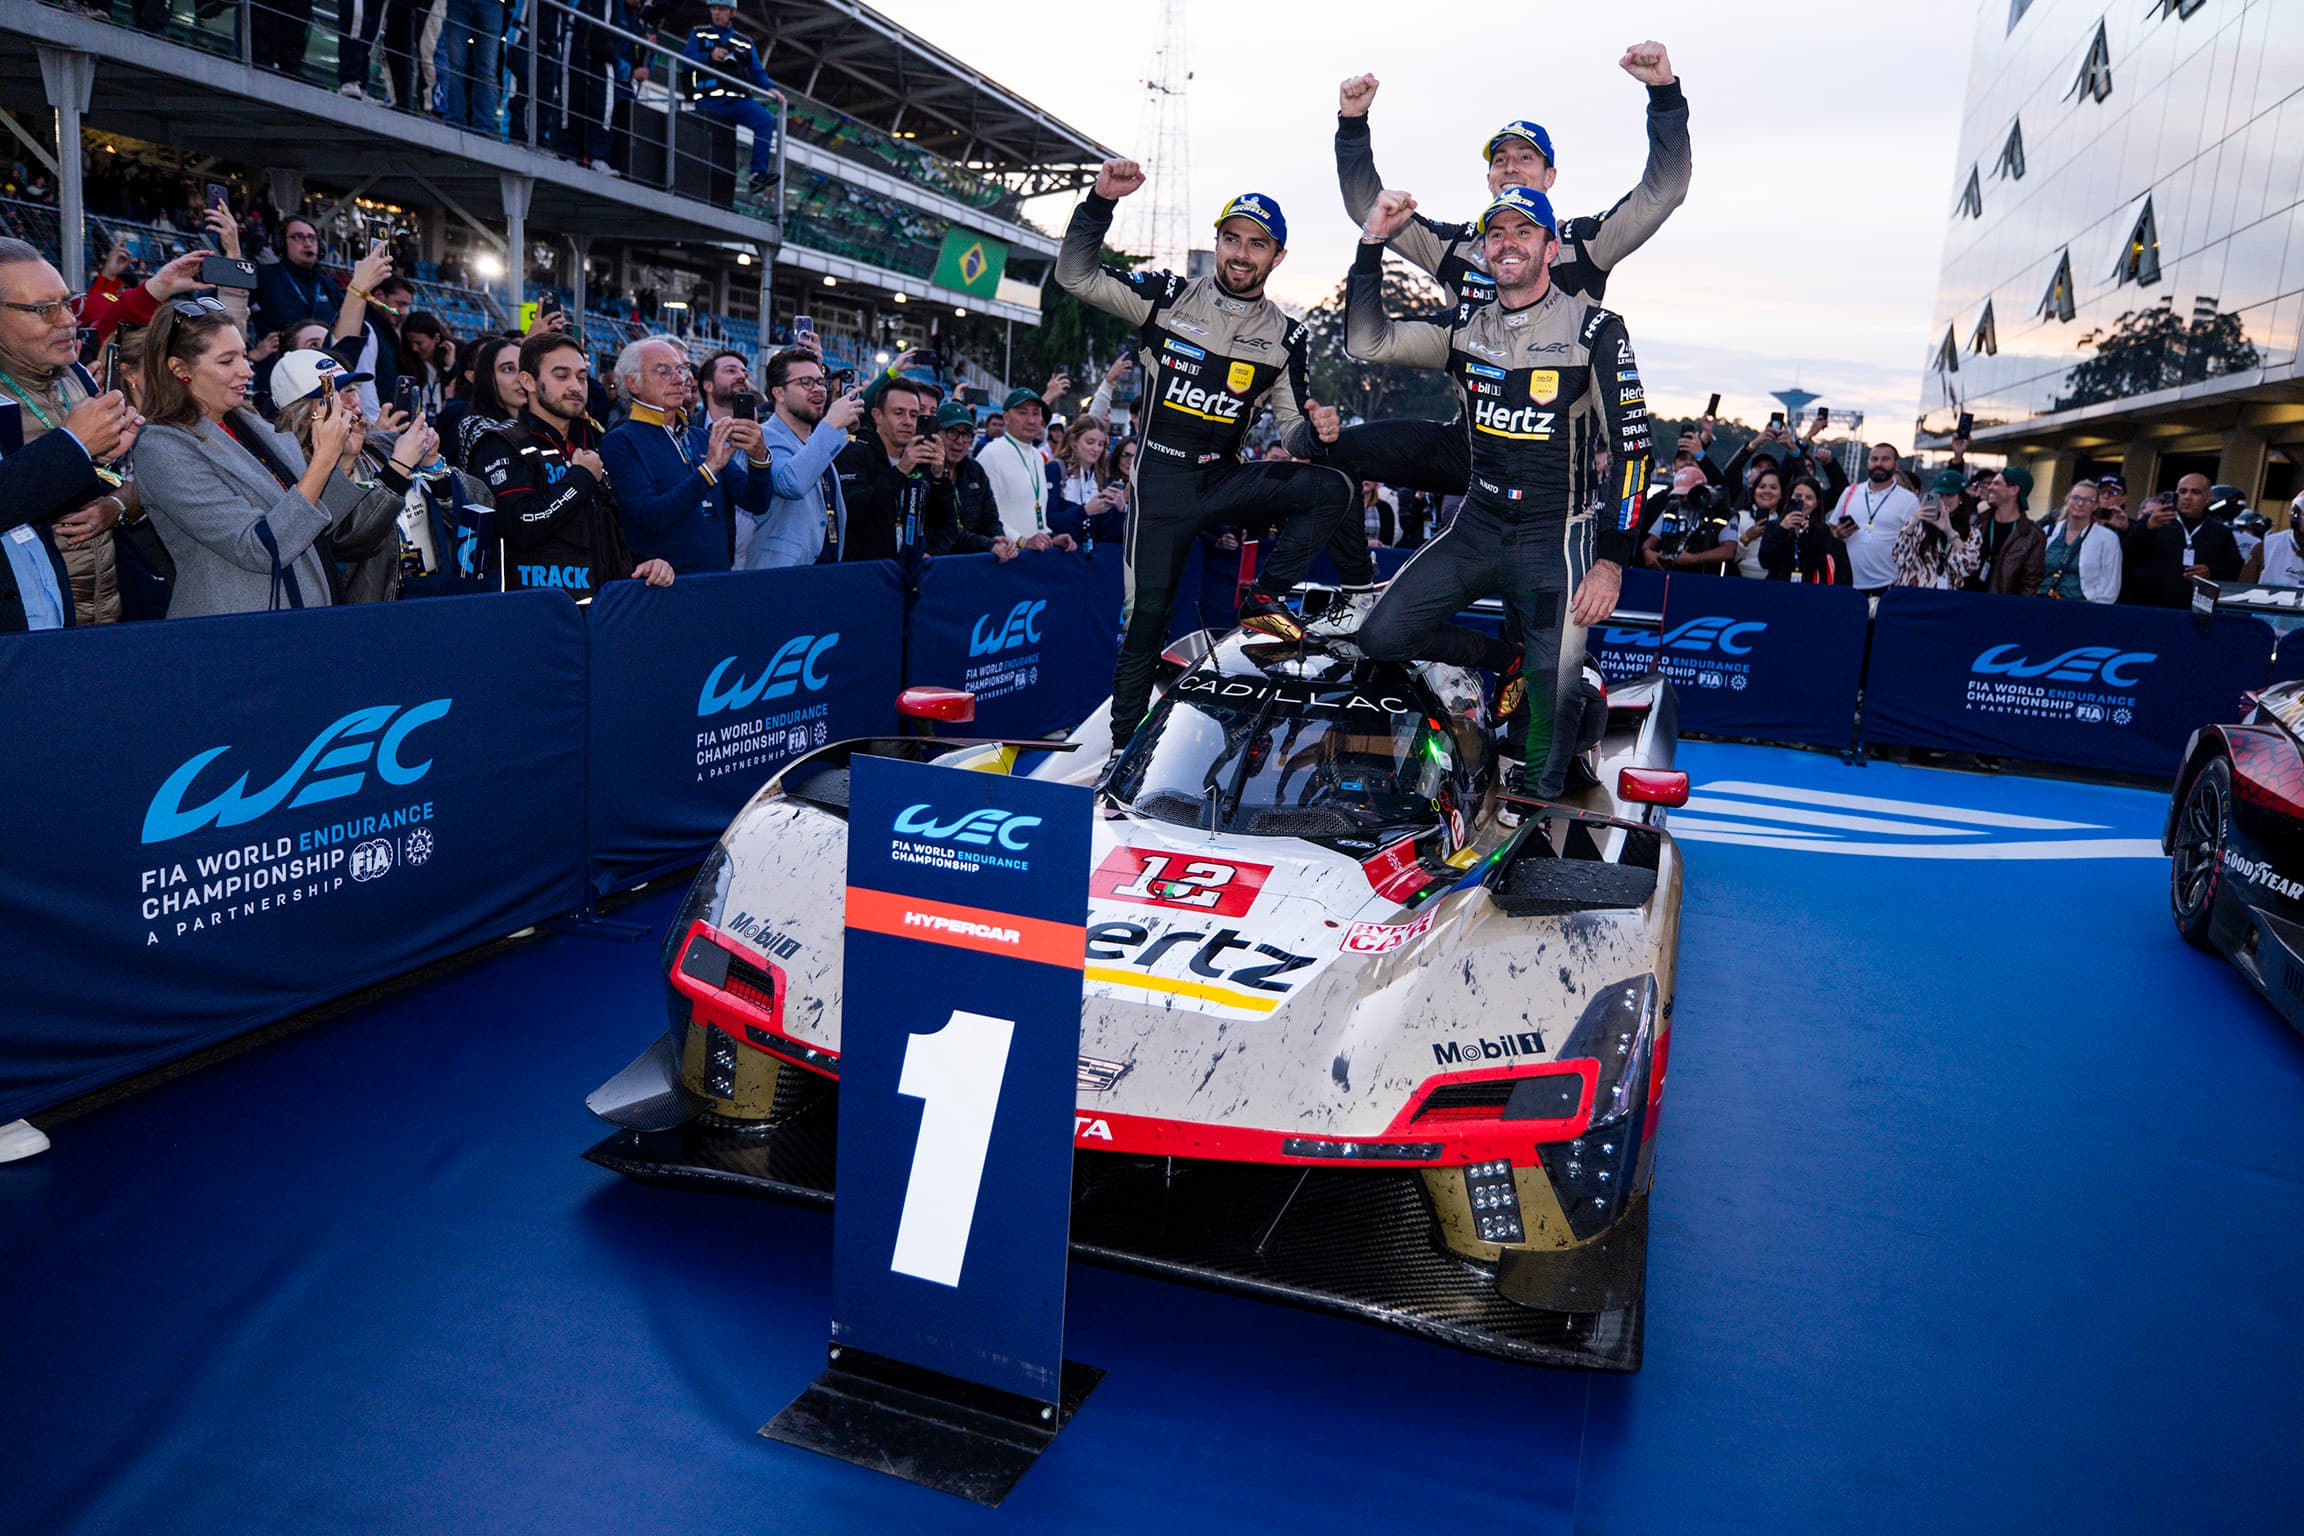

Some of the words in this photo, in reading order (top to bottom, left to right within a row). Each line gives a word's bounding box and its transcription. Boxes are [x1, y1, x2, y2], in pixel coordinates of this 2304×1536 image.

[1233, 335, 1273, 350] WEC
[1527, 342, 1570, 353] WEC
[1161, 355, 1189, 374] Mobil
[1165, 377, 1244, 418] Hertz
[1475, 400, 1555, 433] Hertz
[517, 565, 590, 589] TRACK
[968, 599, 1047, 657] WEC
[697, 632, 840, 716] WEC
[966, 668, 977, 680] FIA
[979, 661, 1003, 677] WORLD
[1600, 660, 1696, 678] CHAMPINSHIP
[1601, 650, 1620, 661] FIA
[1624, 652, 1670, 666] WORD
[1673, 657, 1750, 673] ENDURANCE
[1971, 643, 2158, 687] WEC
[965, 671, 1015, 693] CHAMPIONSHIP
[1178, 675, 1408, 714] CADILLAC
[1968, 680, 1989, 692] FIA
[1994, 683, 2045, 697] WORLD
[2048, 689, 2136, 707] ENDURANCE
[1967, 692, 2074, 710] CHAMPIONSHIP
[1980, 704, 2072, 720] PARTNERSHIP
[697, 730, 717, 748] FIA
[720, 719, 763, 741] WORLD
[766, 703, 828, 731] ENDURANCE
[697, 730, 786, 765] CHAMPIONSHIP
[141, 698, 452, 844] WEC
[697, 773, 703, 782] A
[710, 750, 785, 778] PARTNERSHIP
[893, 803, 1043, 850] WEC
[141, 863, 187, 892] FIA
[197, 837, 292, 877] WORLD
[299, 801, 434, 851] ENDURANCE
[892, 840, 911, 851] FIA
[914, 843, 955, 858] WORLD
[957, 851, 1029, 871] ENDURANCE
[892, 851, 980, 872] CHAMPIONSHIP
[142, 848, 345, 920] CHAMPIONSHIP
[1112, 855, 1238, 909] 12
[2224, 849, 2304, 900] GOODYEAR
[147, 931, 159, 945] A
[177, 877, 343, 935] PARTNERSHIP
[904, 911, 1021, 944] HYPERCAR
[728, 911, 786, 951] Mobil
[1086, 910, 1317, 993] ertz
[1432, 1033, 1517, 1065] Mobil
[891, 1009, 1016, 1288] 1
